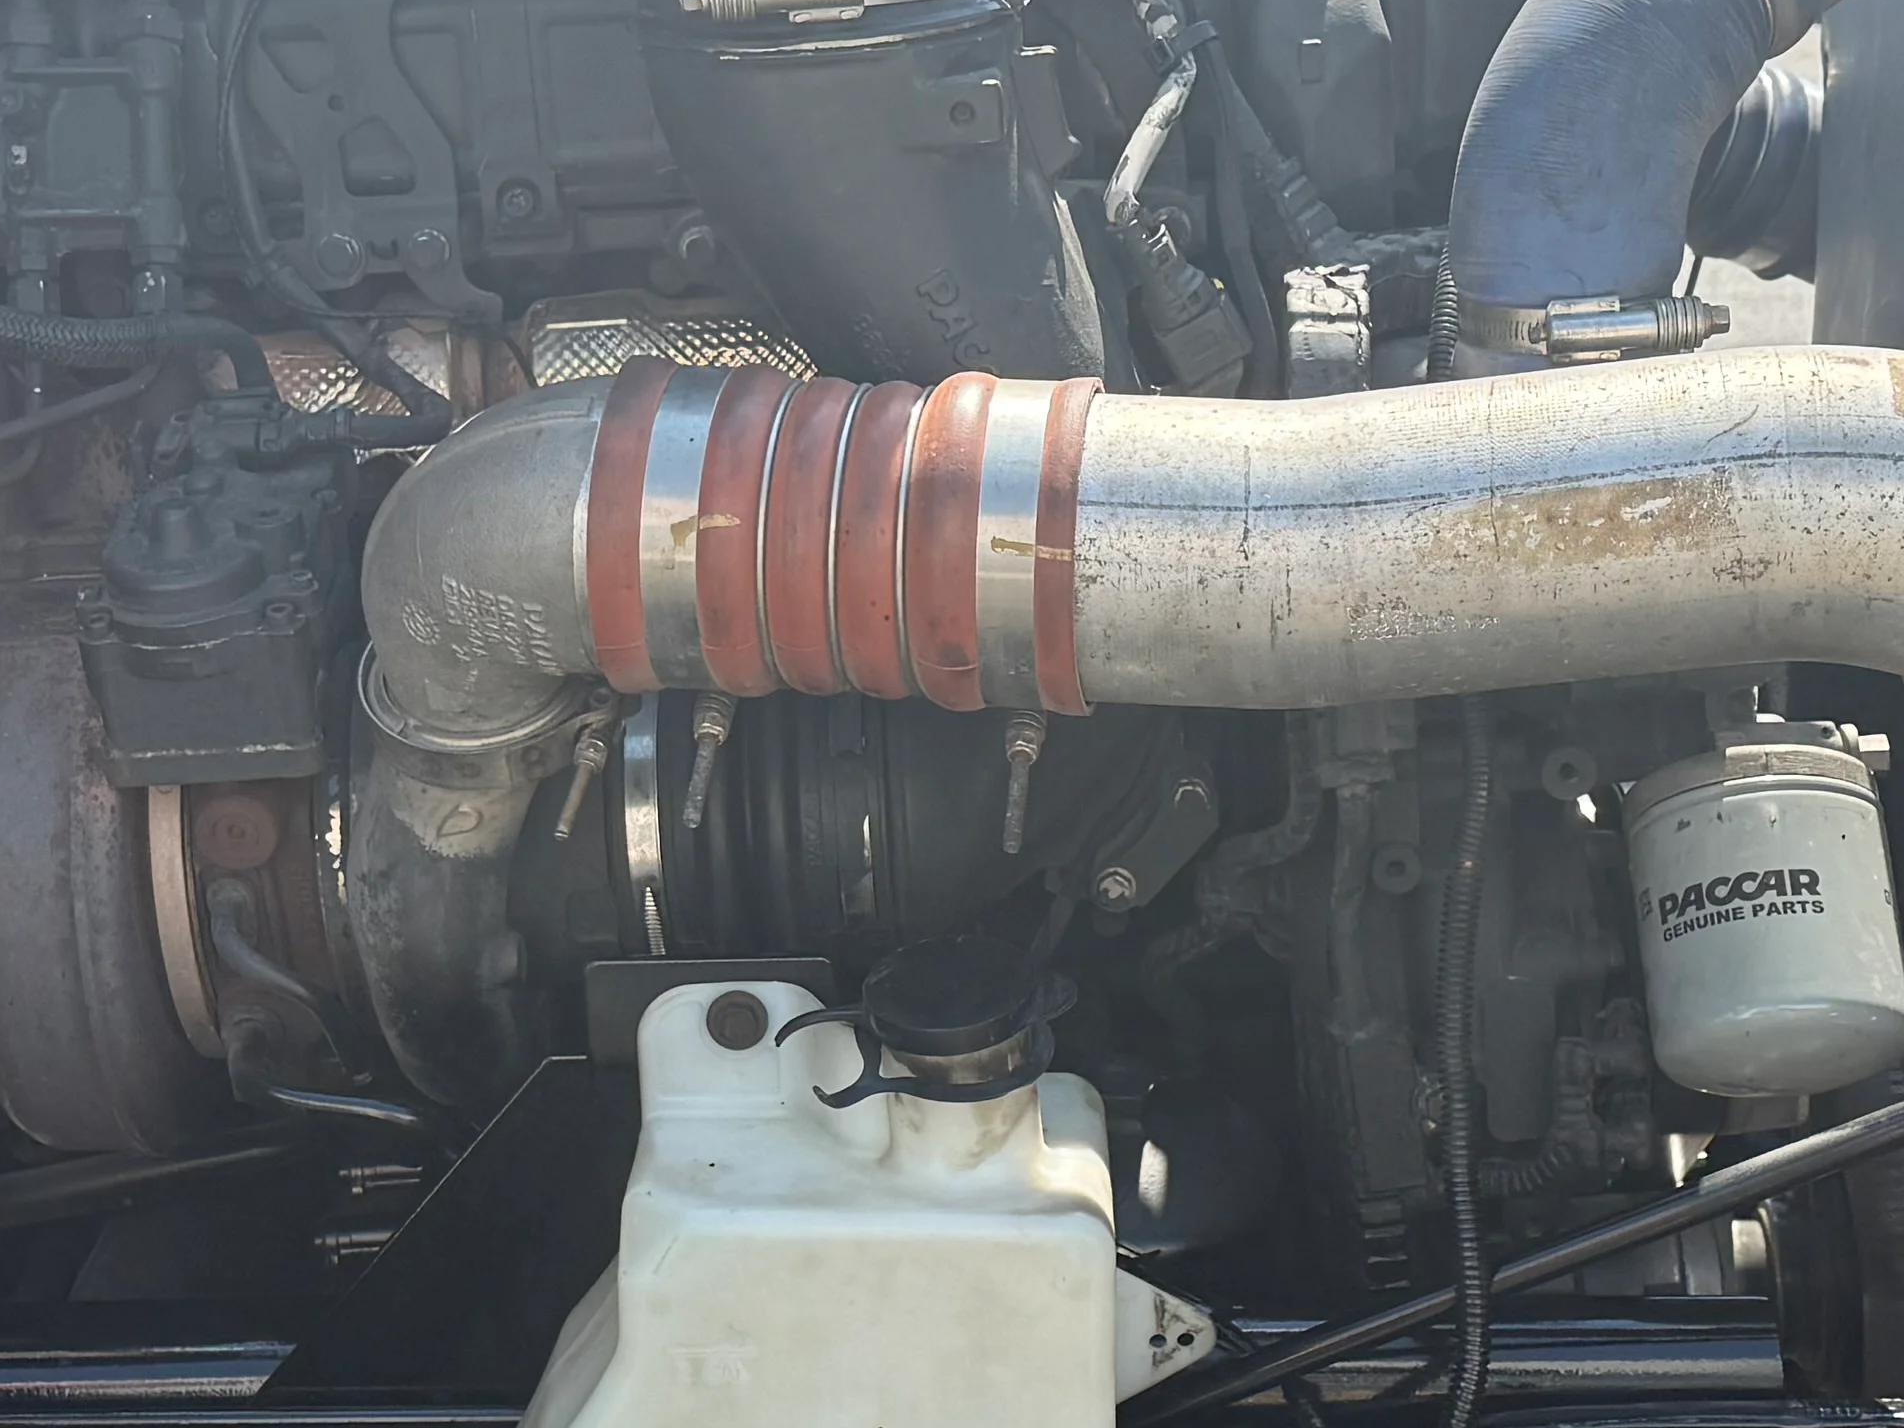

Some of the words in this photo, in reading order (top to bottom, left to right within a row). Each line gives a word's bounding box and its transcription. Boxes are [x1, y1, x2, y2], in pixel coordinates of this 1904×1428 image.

[1658, 868, 1822, 925] PACCAR
[1663, 906, 1746, 943] GENUINE
[1751, 900, 1825, 918] PARTS
